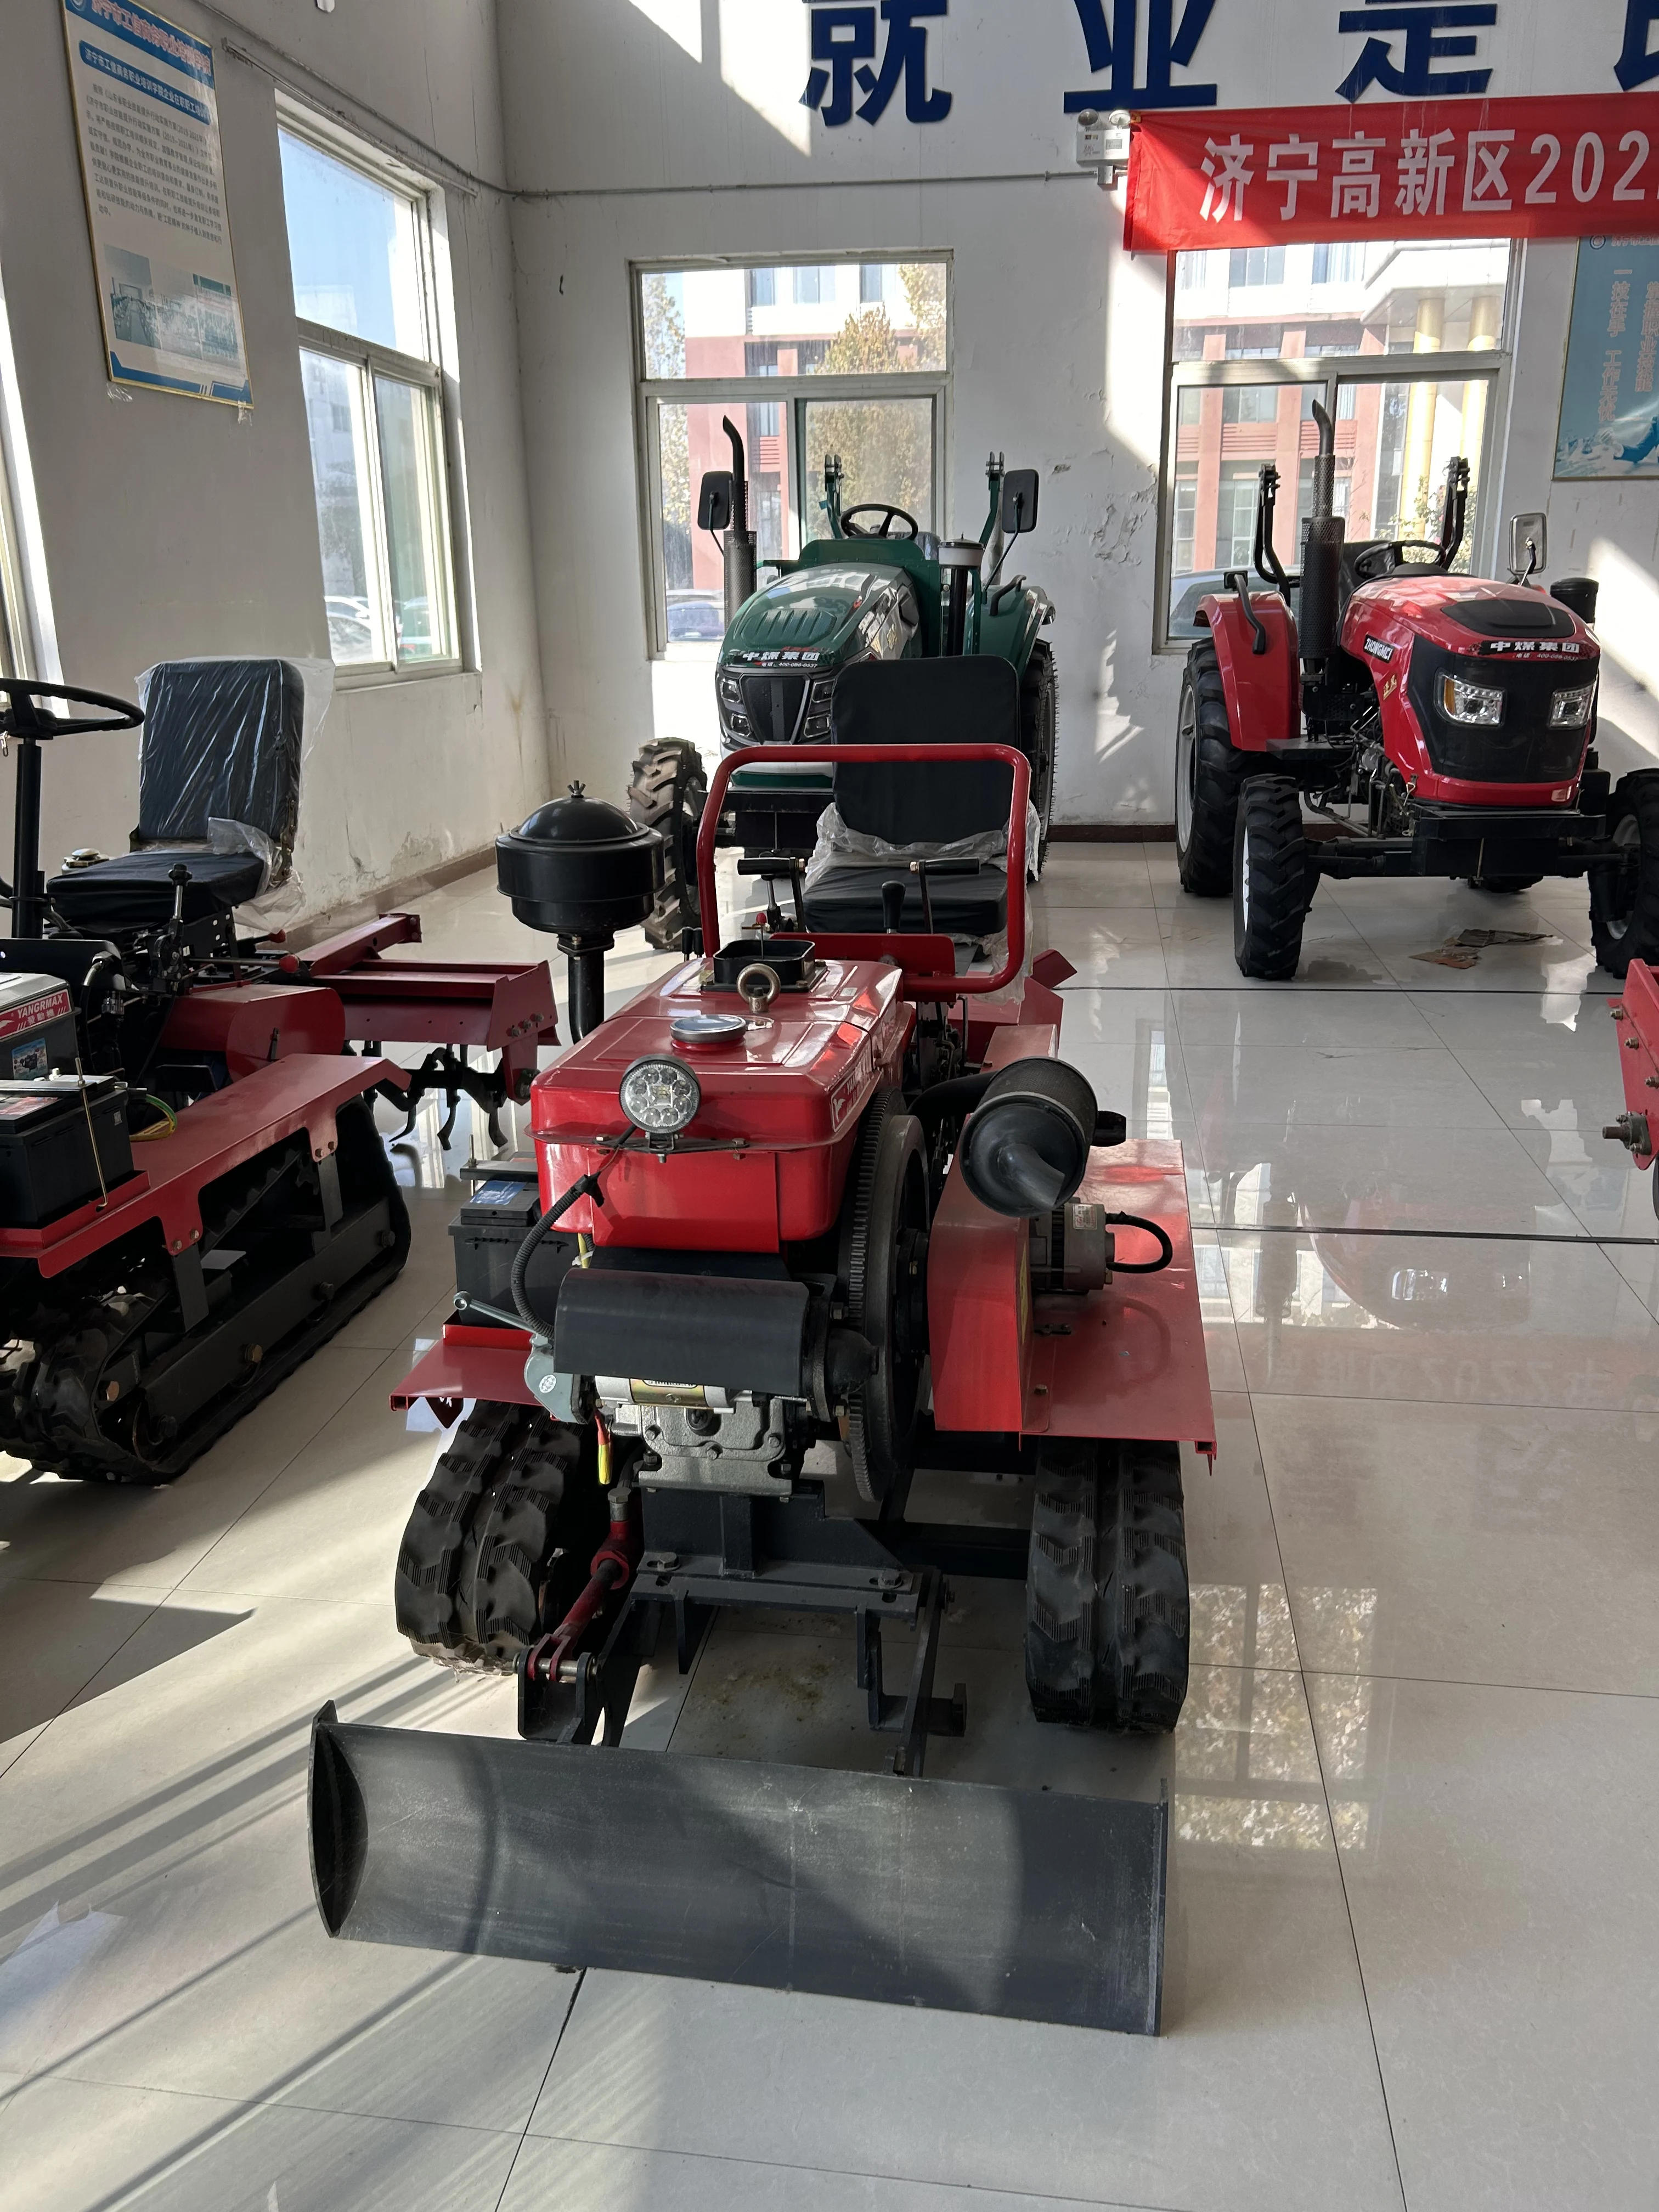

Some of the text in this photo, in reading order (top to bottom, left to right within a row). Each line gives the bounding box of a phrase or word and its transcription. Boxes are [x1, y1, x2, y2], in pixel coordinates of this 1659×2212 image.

[1199, 128, 1659, 224] 济宁高新区202
[1598, 269, 1633, 422] 一技在手 工作无忧
[742, 651, 820, 662] 中煤集团
[1490, 641, 1580, 653] 中煤集团
[18, 994, 63, 1019] YANGRMAX
